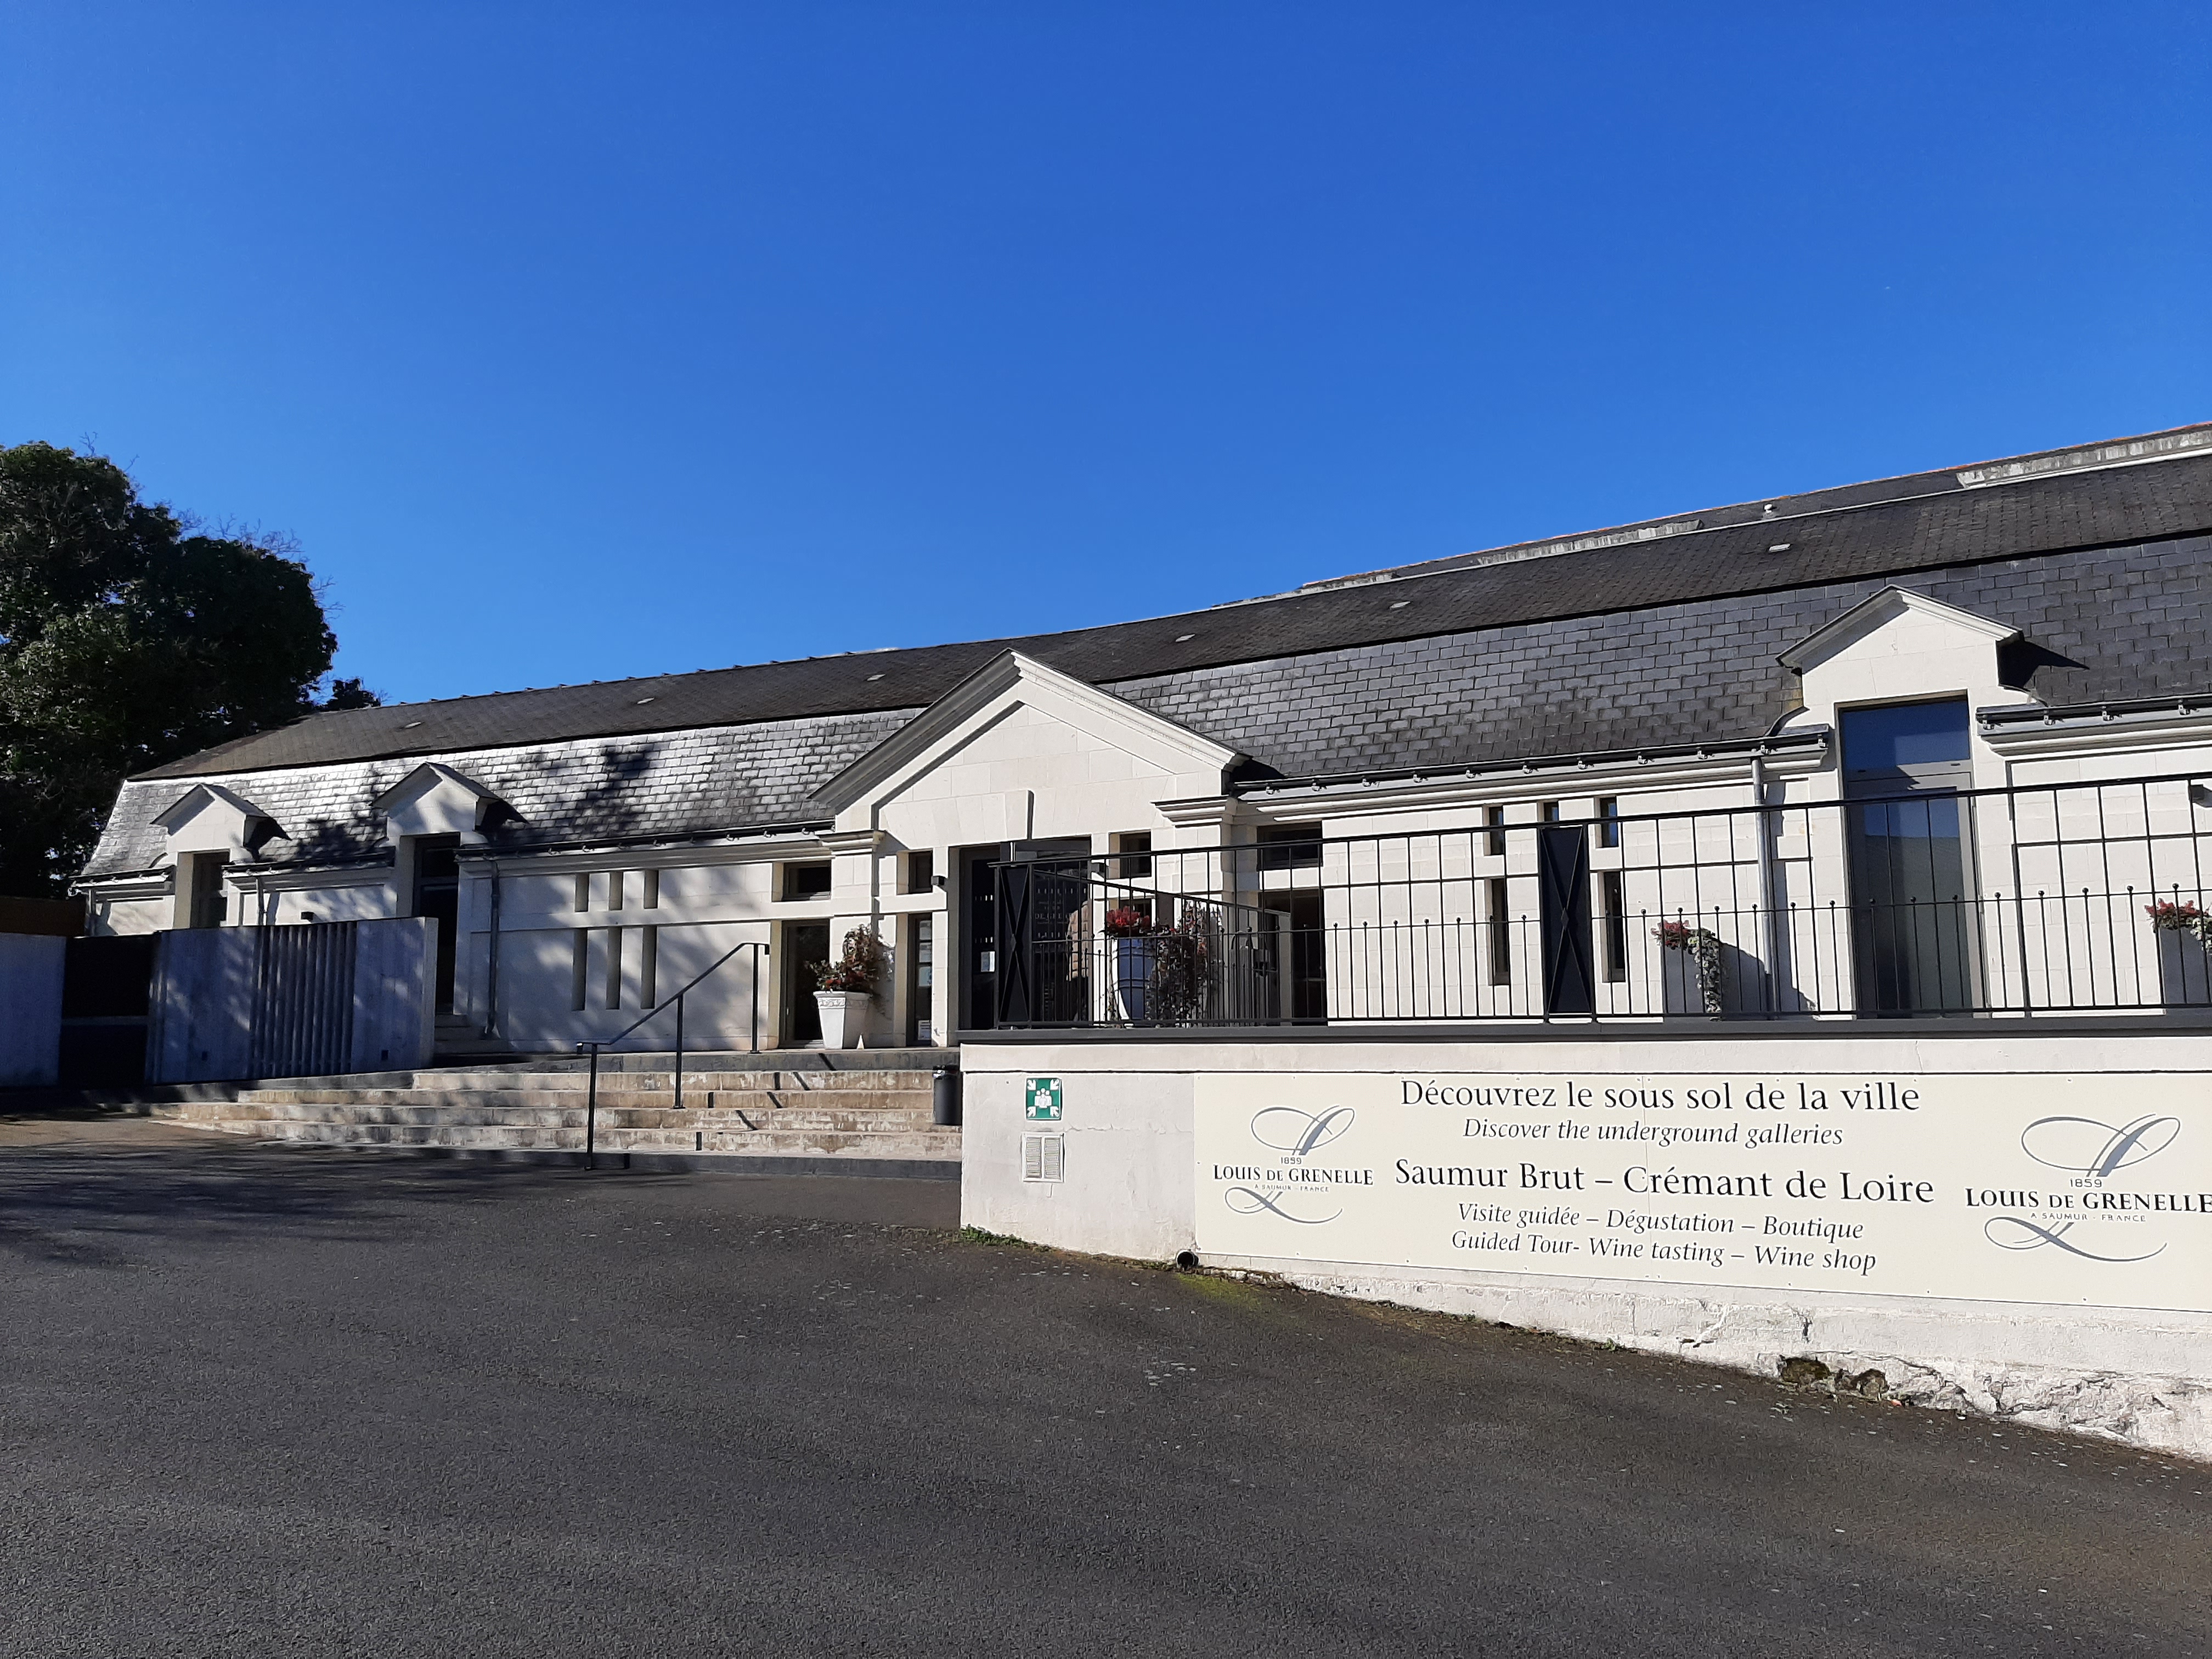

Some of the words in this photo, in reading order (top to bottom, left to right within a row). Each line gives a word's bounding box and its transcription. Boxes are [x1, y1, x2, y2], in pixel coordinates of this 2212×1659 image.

[1401, 1080, 1556, 1107] Découvrez
[1566, 1081, 1593, 1108] le
[1605, 1088, 1674, 1109] sous
[1686, 1082, 1733, 1109] sol
[1745, 1082, 1785, 1110] de
[1797, 1082, 1829, 1110] la
[1839, 1081, 1919, 1111] ville
[1463, 1119, 1551, 1139] Discover
[1557, 1120, 1590, 1141] the
[1598, 1120, 1738, 1147] underground
[1745, 1123, 1843, 1149] galleries
[1213, 1164, 1261, 1181] LOUIS
[1267, 1170, 1283, 1181] DE
[1288, 1168, 1373, 1186] GRENELLE
[1396, 1159, 1508, 1187] Saumur
[1519, 1163, 1585, 1191] Brut
[1624, 1166, 1773, 1198] Crémant
[1786, 1170, 1827, 1200] de
[1839, 1172, 1934, 1203] Loire
[2070, 1178, 2102, 1188] 1859
[1965, 1188, 2039, 1207] LOUIS
[2049, 1195, 2074, 1209] DE
[2083, 1192, 2212, 1213] GRENELLE
[1459, 1203, 1511, 1223] Visite
[1516, 1206, 1581, 1228] guidée
[1606, 1209, 1734, 1234] Dégustation
[1763, 1216, 1864, 1244] Boutique
[2042, 1212, 2088, 1221] SAUMUR
[1452, 1231, 1521, 1252] Guided
[1589, 1237, 1644, 1259] Wine
[1651, 1242, 1725, 1268] tasting
[1754, 1245, 1815, 1268] Wine
[1822, 1249, 1876, 1277] shop
